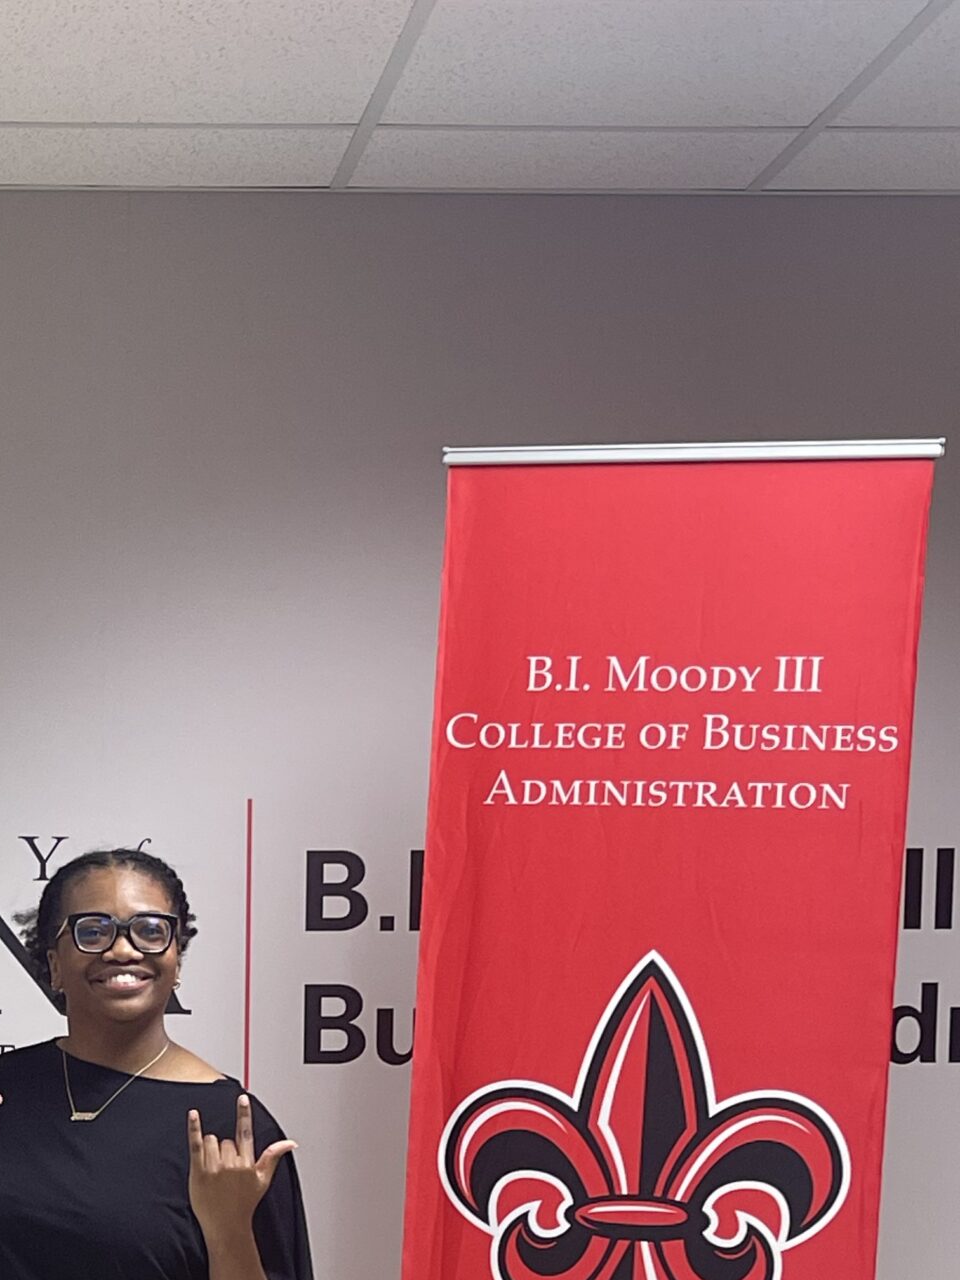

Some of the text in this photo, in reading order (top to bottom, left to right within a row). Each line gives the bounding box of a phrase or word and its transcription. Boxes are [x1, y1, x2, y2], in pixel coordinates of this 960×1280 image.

[526, 655, 825, 694] B.I. MOODY III
[445, 712, 899, 753] COLLEGE OF BUSINESS
[483, 769, 851, 810] ADMINISTRATION
